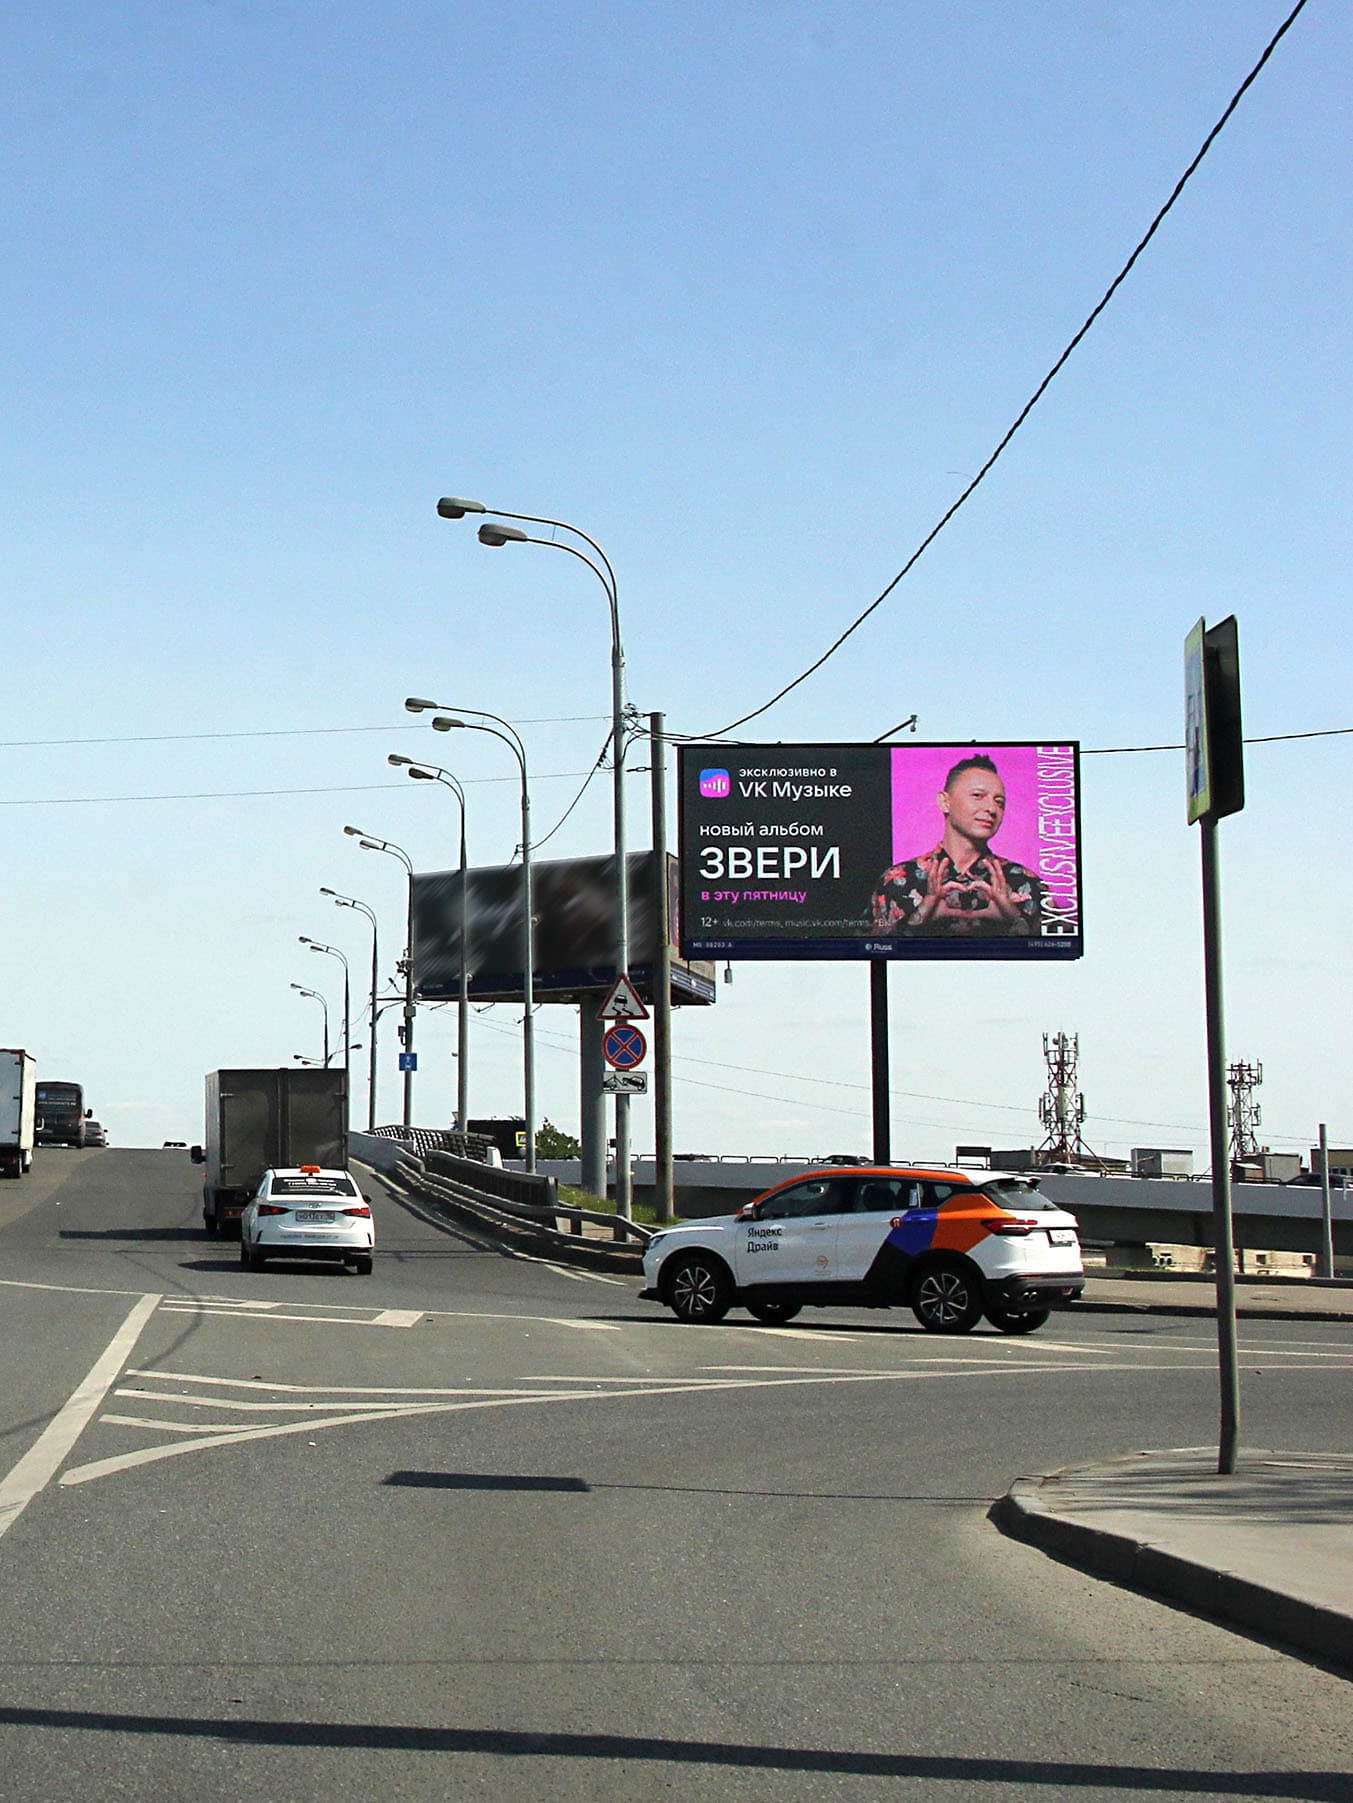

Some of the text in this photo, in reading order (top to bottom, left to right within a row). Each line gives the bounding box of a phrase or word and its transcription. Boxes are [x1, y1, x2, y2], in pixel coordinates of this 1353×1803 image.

[738, 768, 837, 778] эксклюзивно в
[738, 781, 853, 802] VK Музыке
[699, 822, 824, 837] новый альбом
[699, 846, 841, 879] ЗВЕРИ
[701, 891, 808, 904] в эту пятницу
[700, 916, 718, 928] 12+
[747, 1227, 782, 1238] Яндекс
[746, 1241, 779, 1253] Драйв
